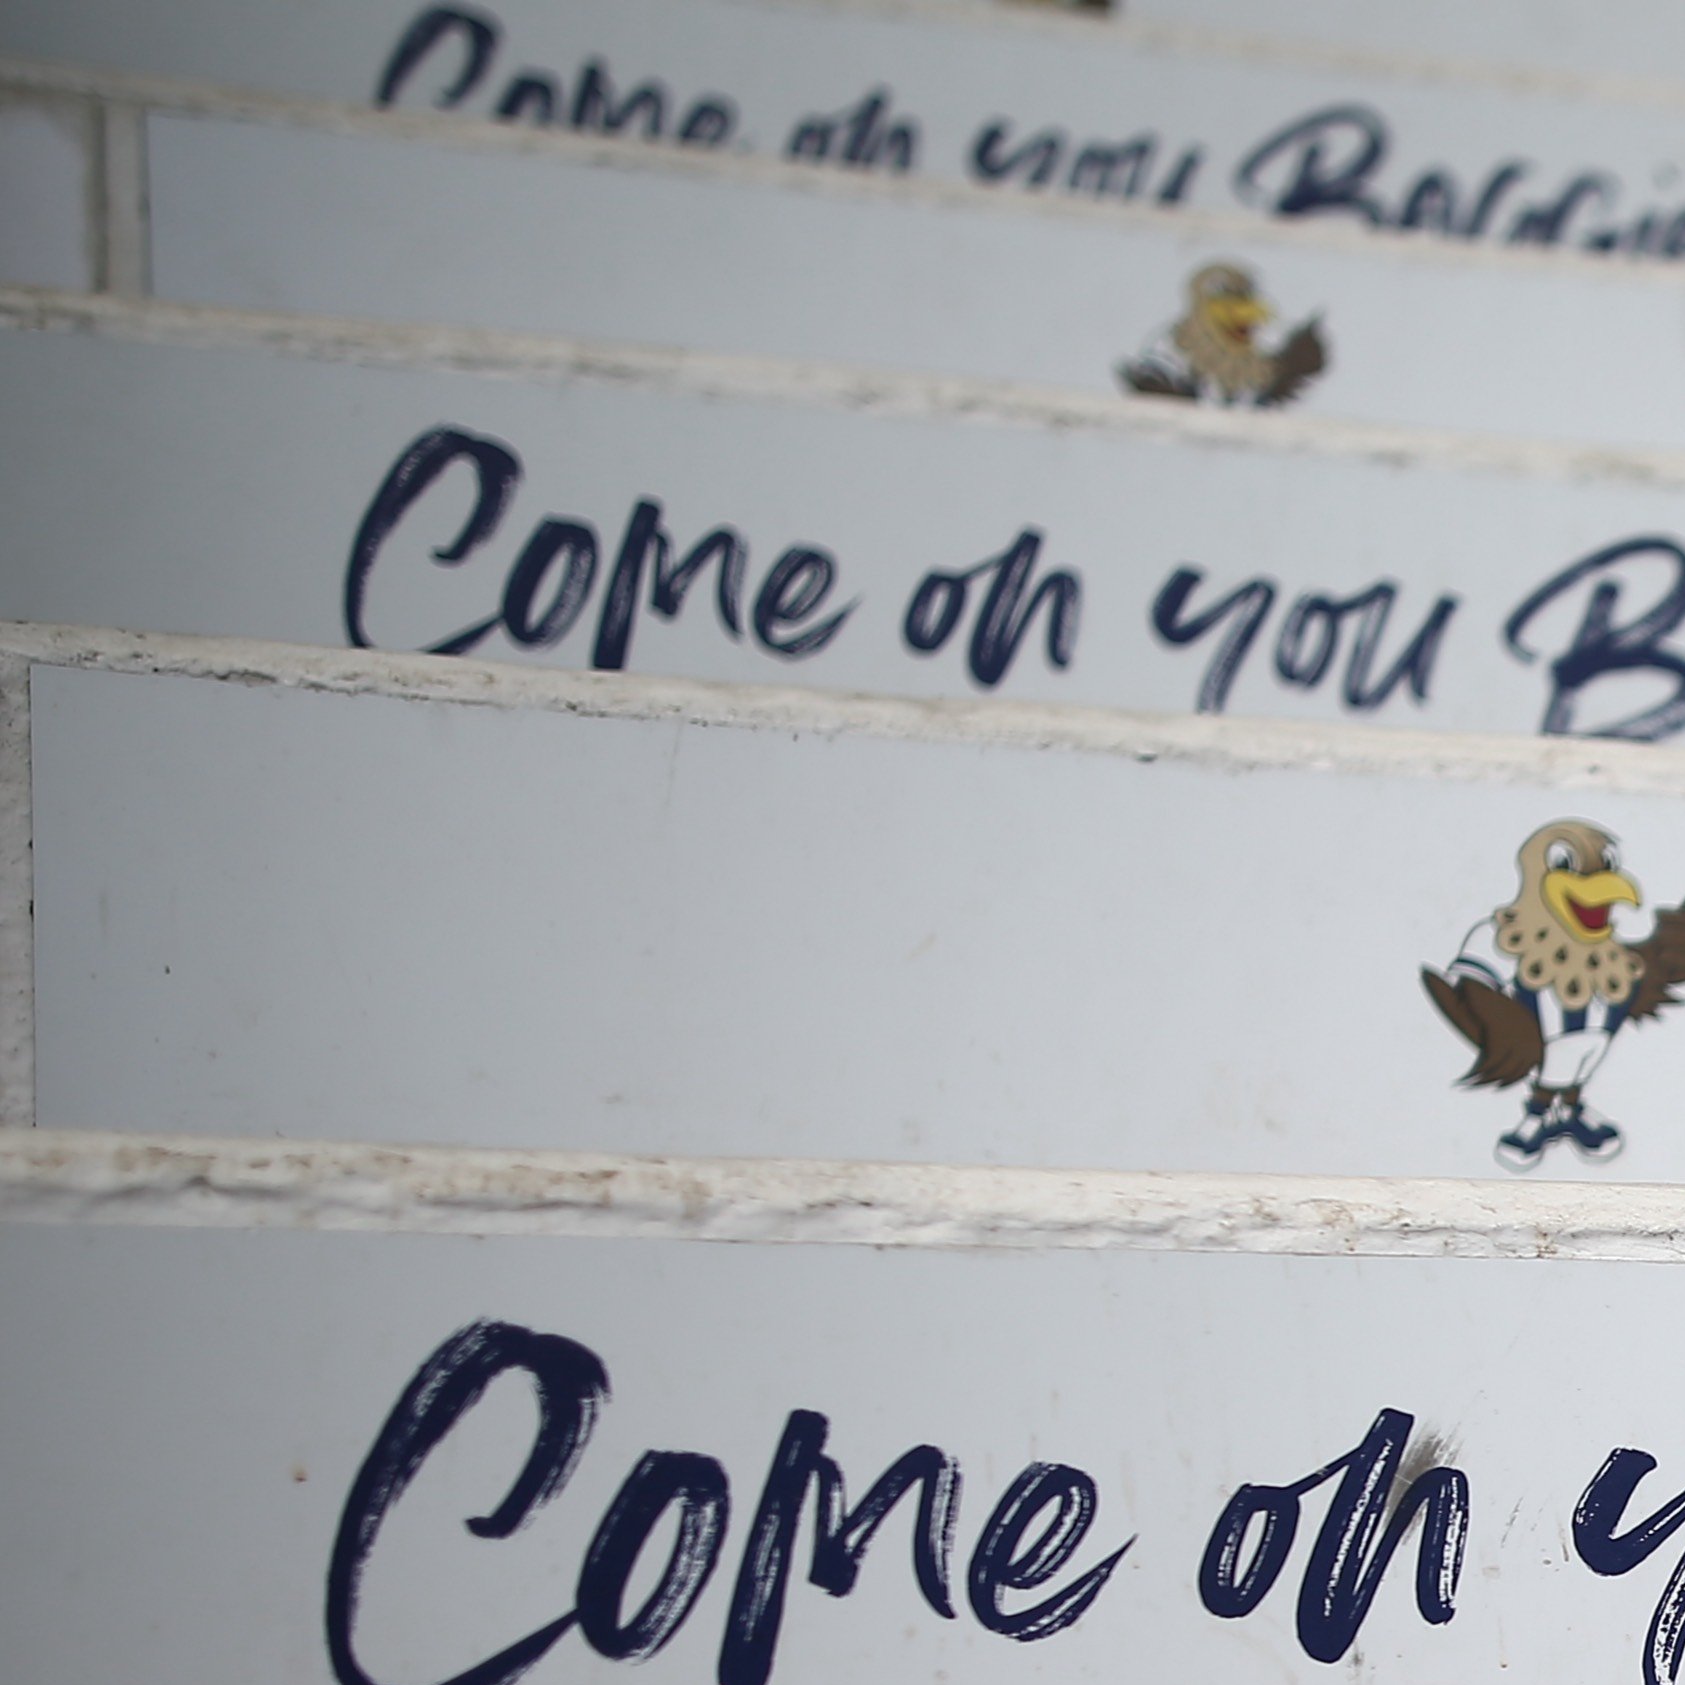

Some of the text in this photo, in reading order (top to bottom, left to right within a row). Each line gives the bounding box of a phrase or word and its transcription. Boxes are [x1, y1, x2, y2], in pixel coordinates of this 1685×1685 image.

[342, 425, 856, 673] Come
[900, 526, 1082, 692] on
[1148, 564, 1462, 715] you
[1196, 1406, 1471, 1665] on
